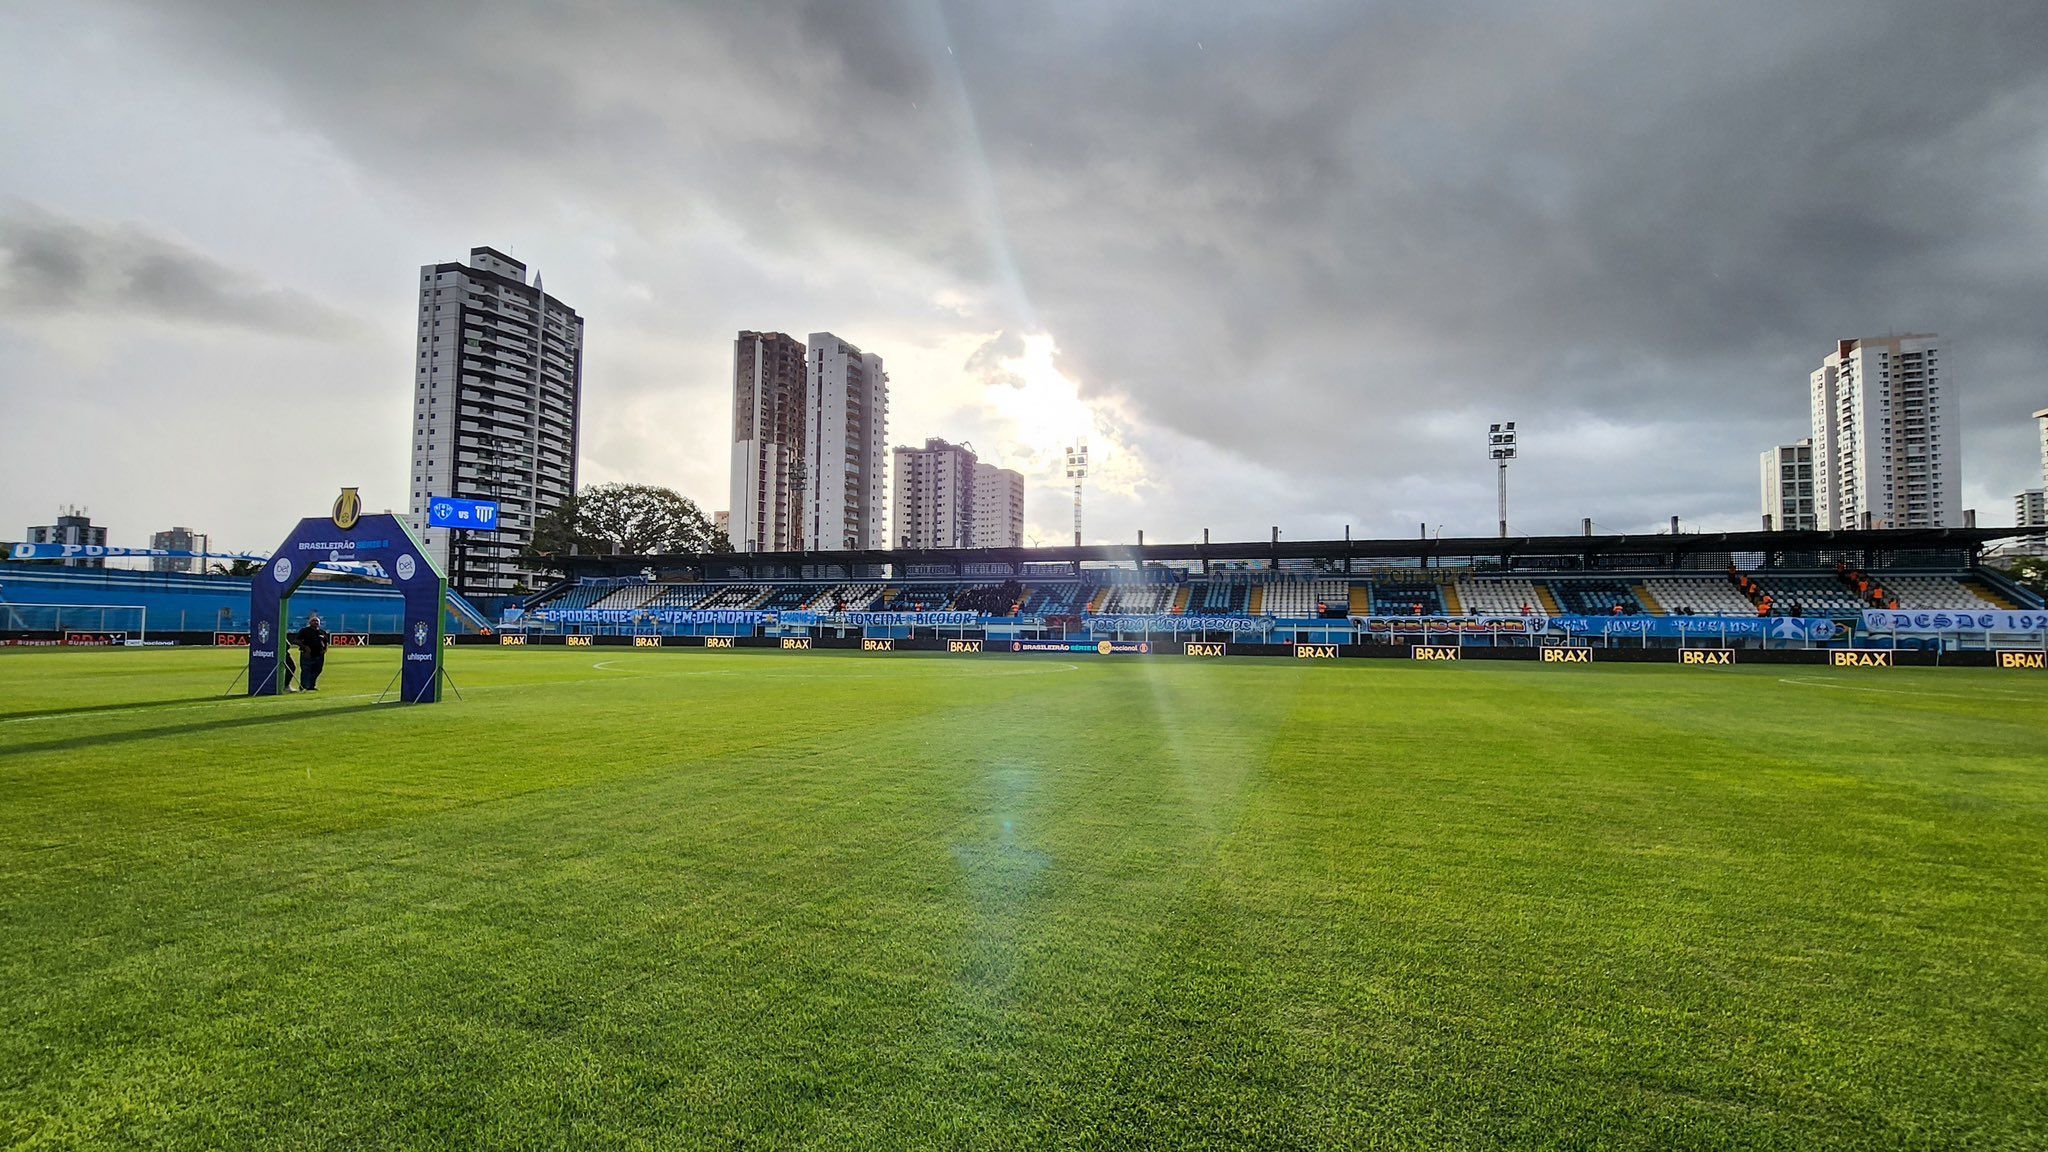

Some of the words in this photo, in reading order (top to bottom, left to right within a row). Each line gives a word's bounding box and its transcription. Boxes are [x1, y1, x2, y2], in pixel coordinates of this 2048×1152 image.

[298, 540, 355, 550] BRASILEIRÃO
[559, 610, 599, 622] PODER
[602, 610, 627, 623] QUE
[664, 611, 692, 623] VEM
[717, 611, 763, 624] NORTE
[848, 613, 903, 625] TORCIDA
[915, 613, 972, 625] BICOLOR
[1892, 613, 1995, 629] DESDE
[217, 634, 251, 646] BRA
[332, 635, 366, 646] BRAX
[502, 636, 525, 646] BRAX
[567, 636, 590, 646] BRAX
[635, 637, 659, 647] BRAX
[706, 637, 731, 648] BRAX
[783, 639, 809, 650] BRAX
[863, 640, 891, 651] BRAX
[950, 641, 979, 653] BRAX
[1187, 644, 1221, 656] BRAX
[1297, 646, 1335, 658] BRAX
[252, 649, 274, 659] uhlsport
[407, 652, 432, 662] uhlsport
[1415, 647, 1456, 660] BRAX
[1544, 649, 1588, 662] BRAX
[1683, 651, 1730, 664] BRAX
[1835, 652, 1887, 666] BRAX
[2002, 653, 2044, 667] BRAX
